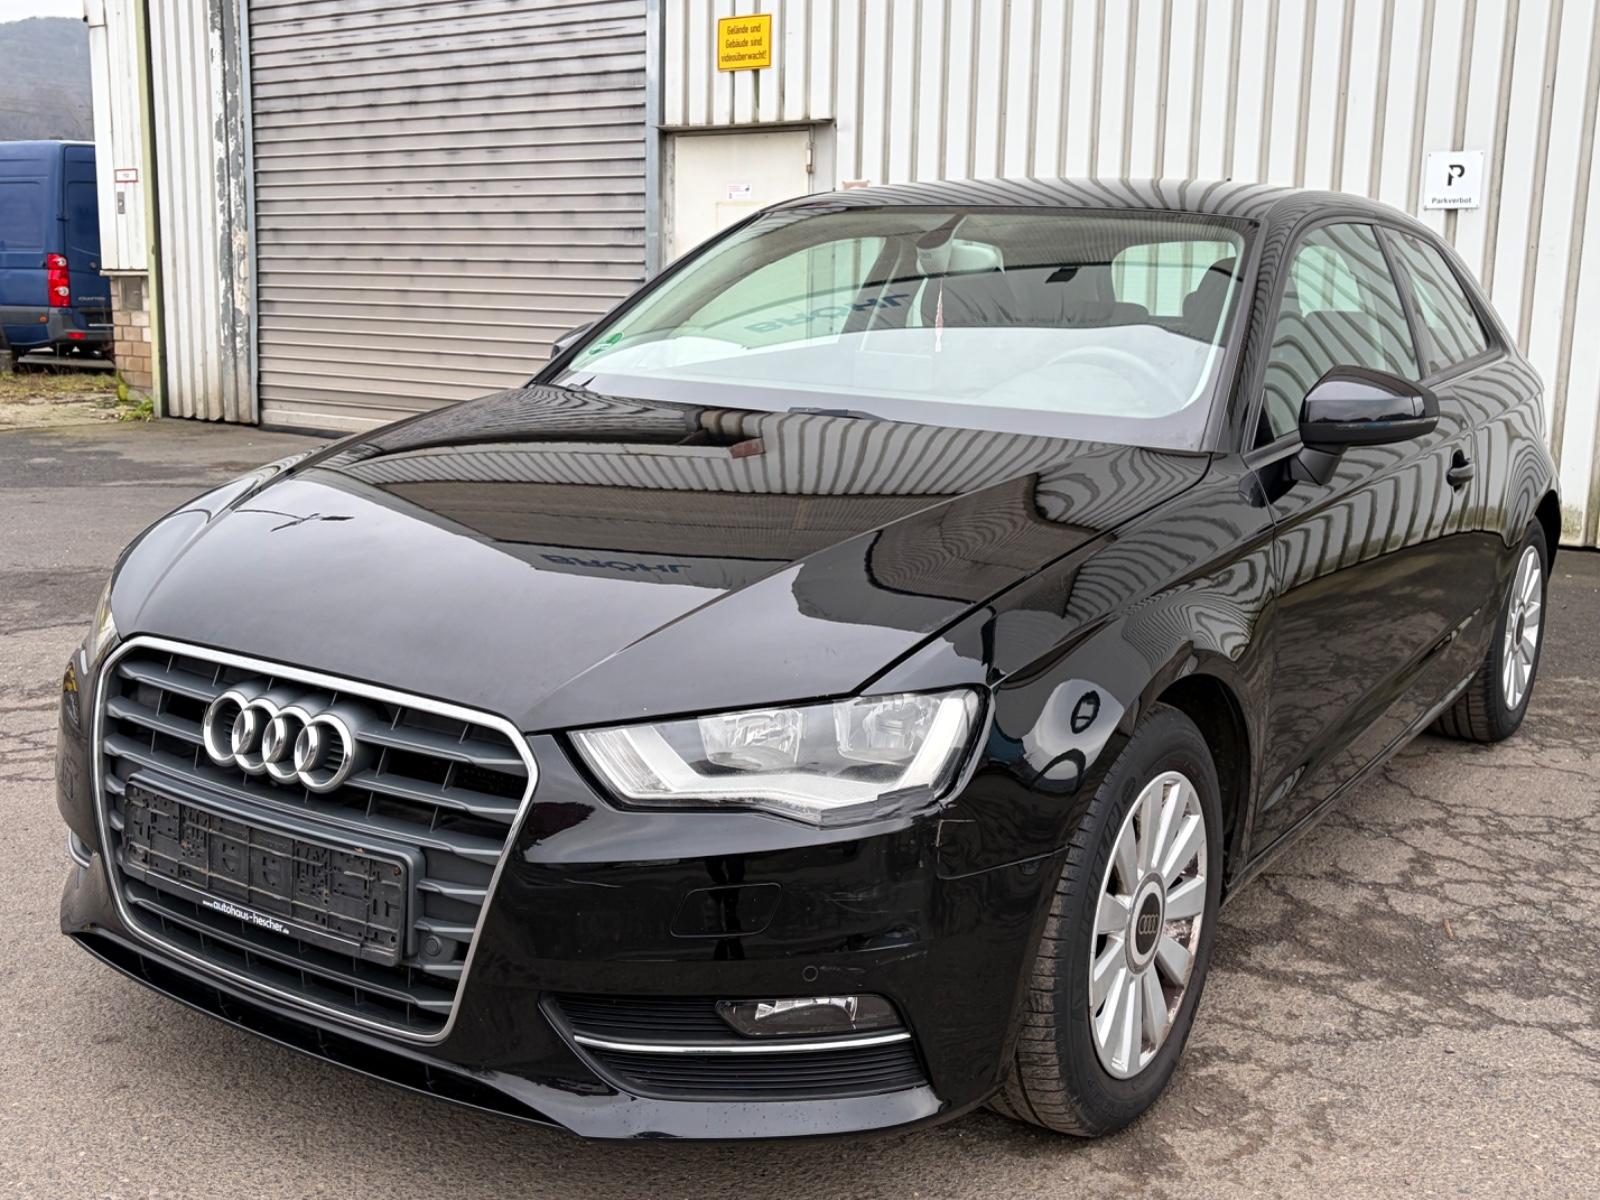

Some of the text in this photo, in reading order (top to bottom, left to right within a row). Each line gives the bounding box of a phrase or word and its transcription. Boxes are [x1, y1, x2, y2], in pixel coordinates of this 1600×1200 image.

[727, 24, 761, 35] Gelände und
[725, 37, 762, 48] Gebäude sind
